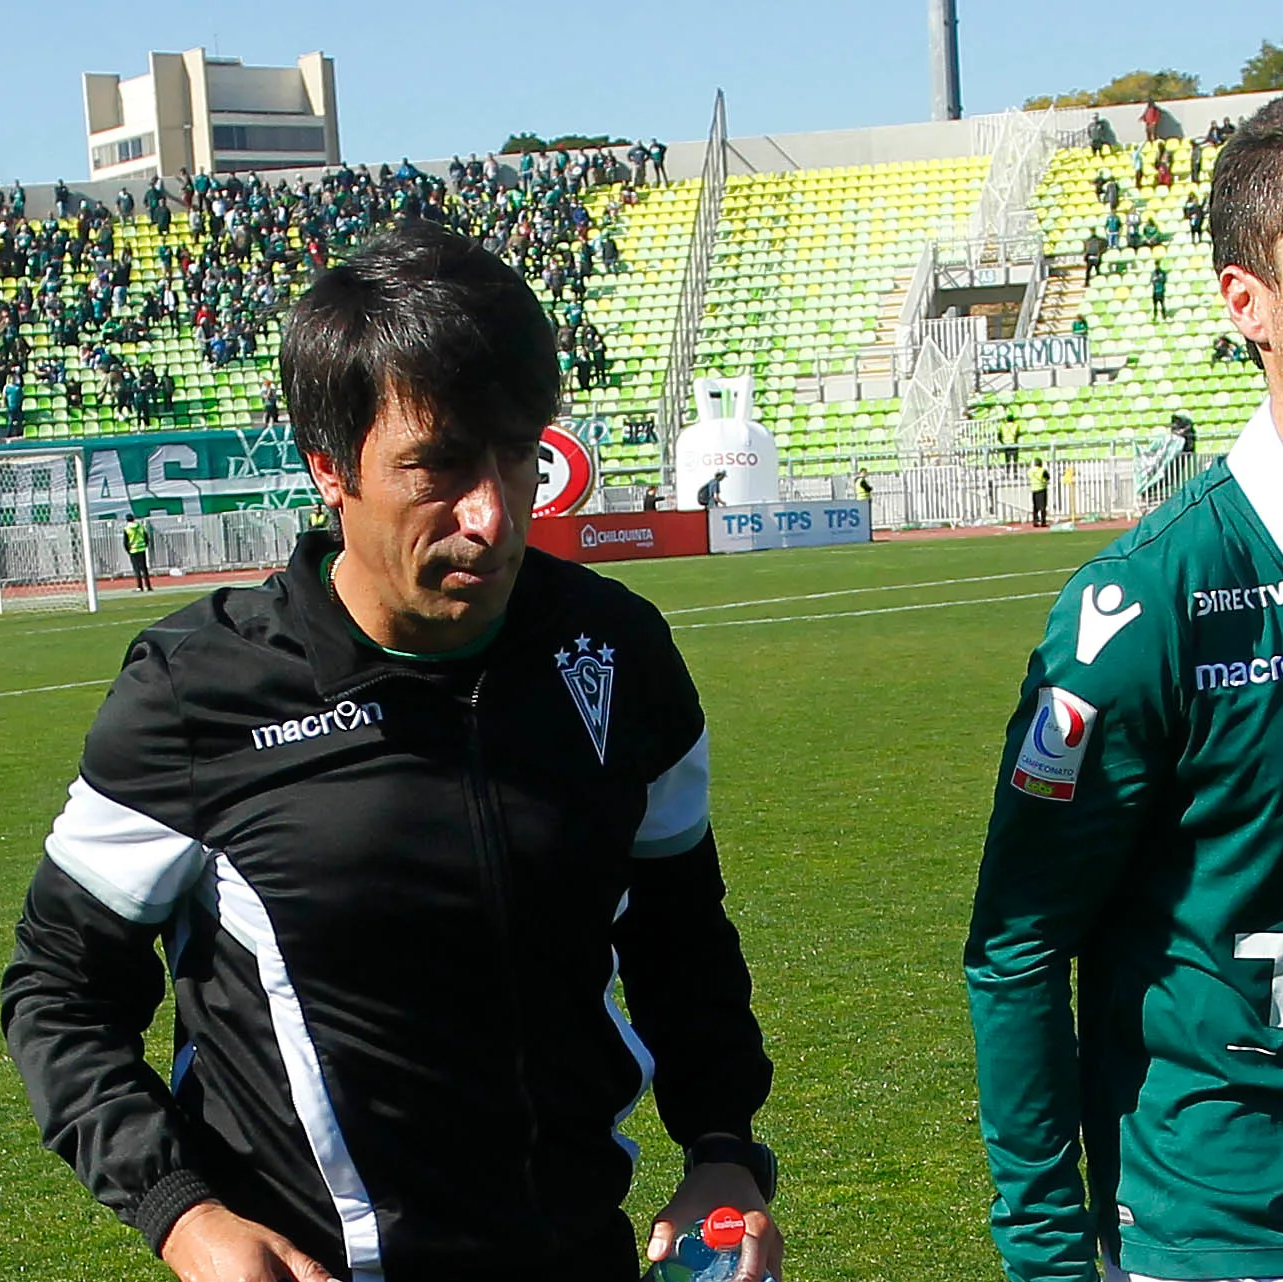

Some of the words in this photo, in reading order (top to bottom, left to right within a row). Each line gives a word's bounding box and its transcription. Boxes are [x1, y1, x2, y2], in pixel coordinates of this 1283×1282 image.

[723, 513, 764, 534] TPS
[774, 511, 813, 531] TPS
[824, 508, 861, 529] TPS
[597, 528, 654, 543] CHILQUINTA
[250, 701, 384, 751] macron
